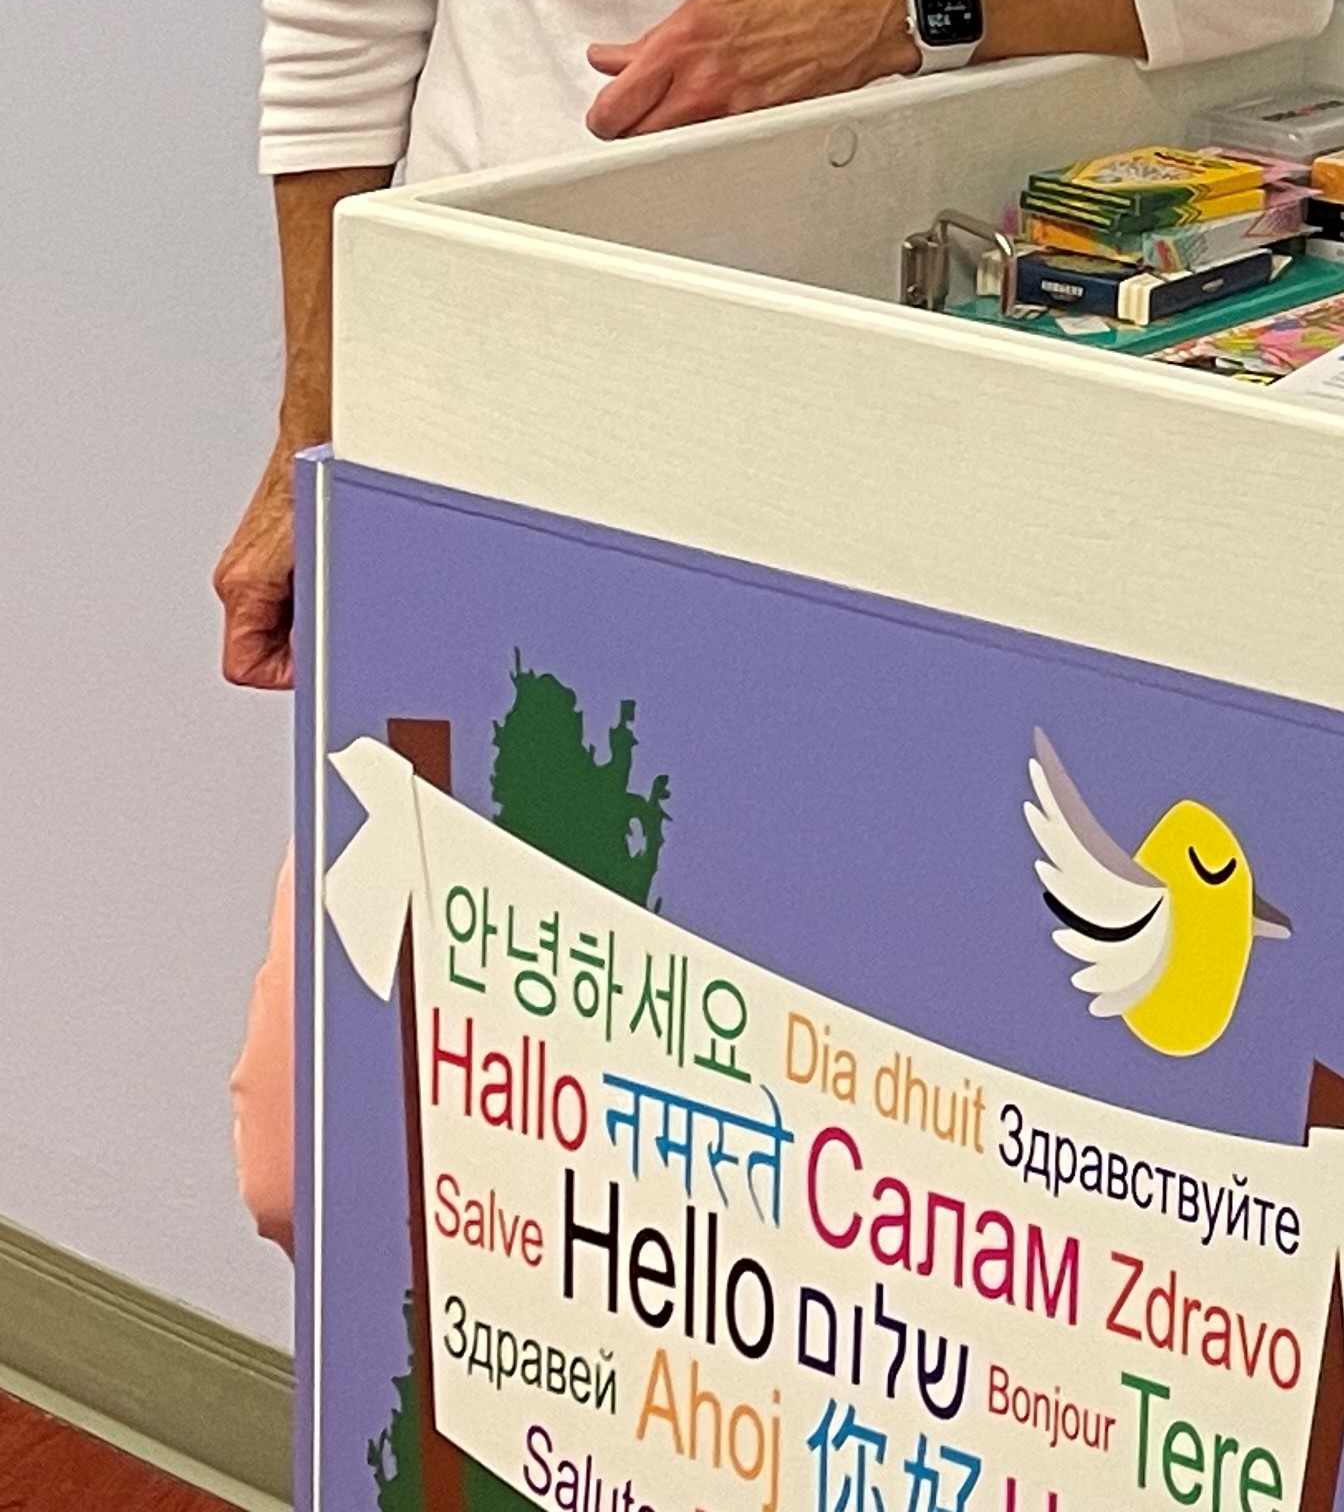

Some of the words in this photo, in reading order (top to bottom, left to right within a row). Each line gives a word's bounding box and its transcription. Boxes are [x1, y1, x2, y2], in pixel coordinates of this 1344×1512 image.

[445, 885, 752, 1084] 안녕하세요
[431, 1007, 588, 1152] Hallo
[603, 1072, 795, 1229] नमस्ते
[785, 1012, 857, 1105] Dia
[874, 1052, 987, 1155] dhuit
[434, 1173, 544, 1268] Salve
[807, 1126, 1081, 1326] Салам
[998, 1103, 1301, 1256] Здравствуйте
[563, 1168, 775, 1360] Hello
[1105, 1251, 1302, 1391] Zdravo
[443, 1295, 617, 1415] Здравей
[798, 1282, 969, 1421] שלום
[988, 1364, 1117, 1454] Bonjour
[636, 1348, 781, 1512] Ahoj
[1120, 1371, 1284, 1512] Tere
